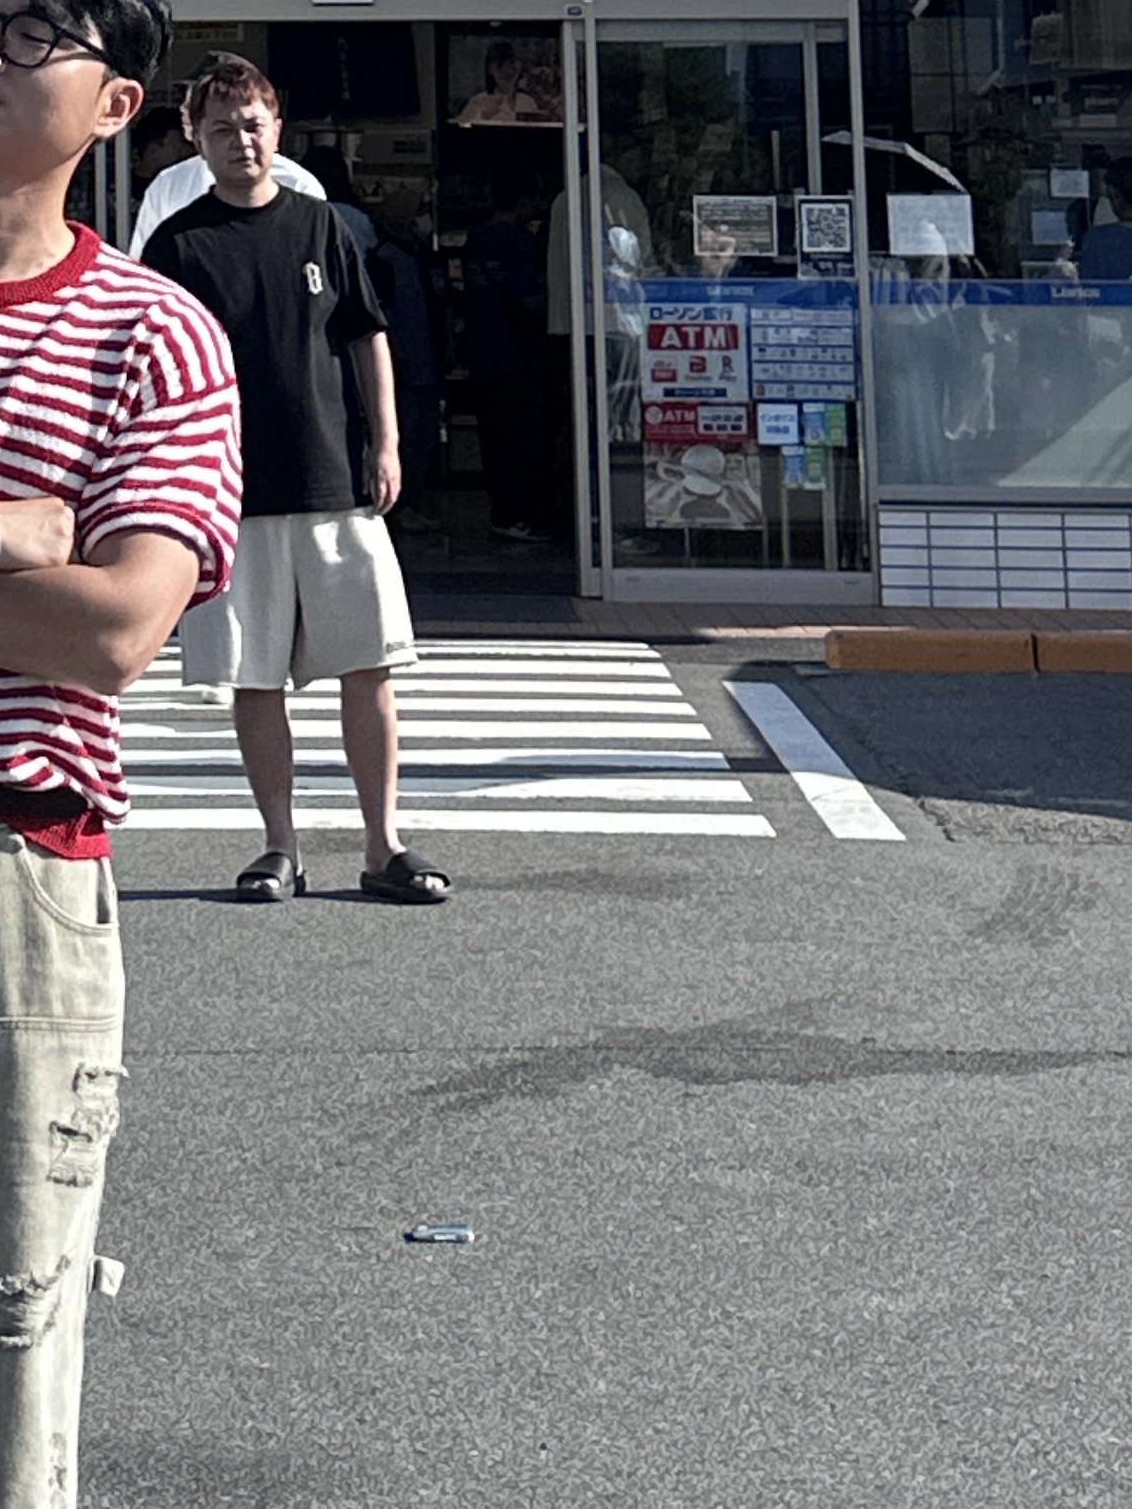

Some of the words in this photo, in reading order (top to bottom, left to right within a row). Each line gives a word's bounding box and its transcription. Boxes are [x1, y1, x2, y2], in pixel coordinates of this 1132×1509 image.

[302, 262, 323, 294] B
[661, 326, 727, 348] ATM
[664, 409, 696, 423] ATM
